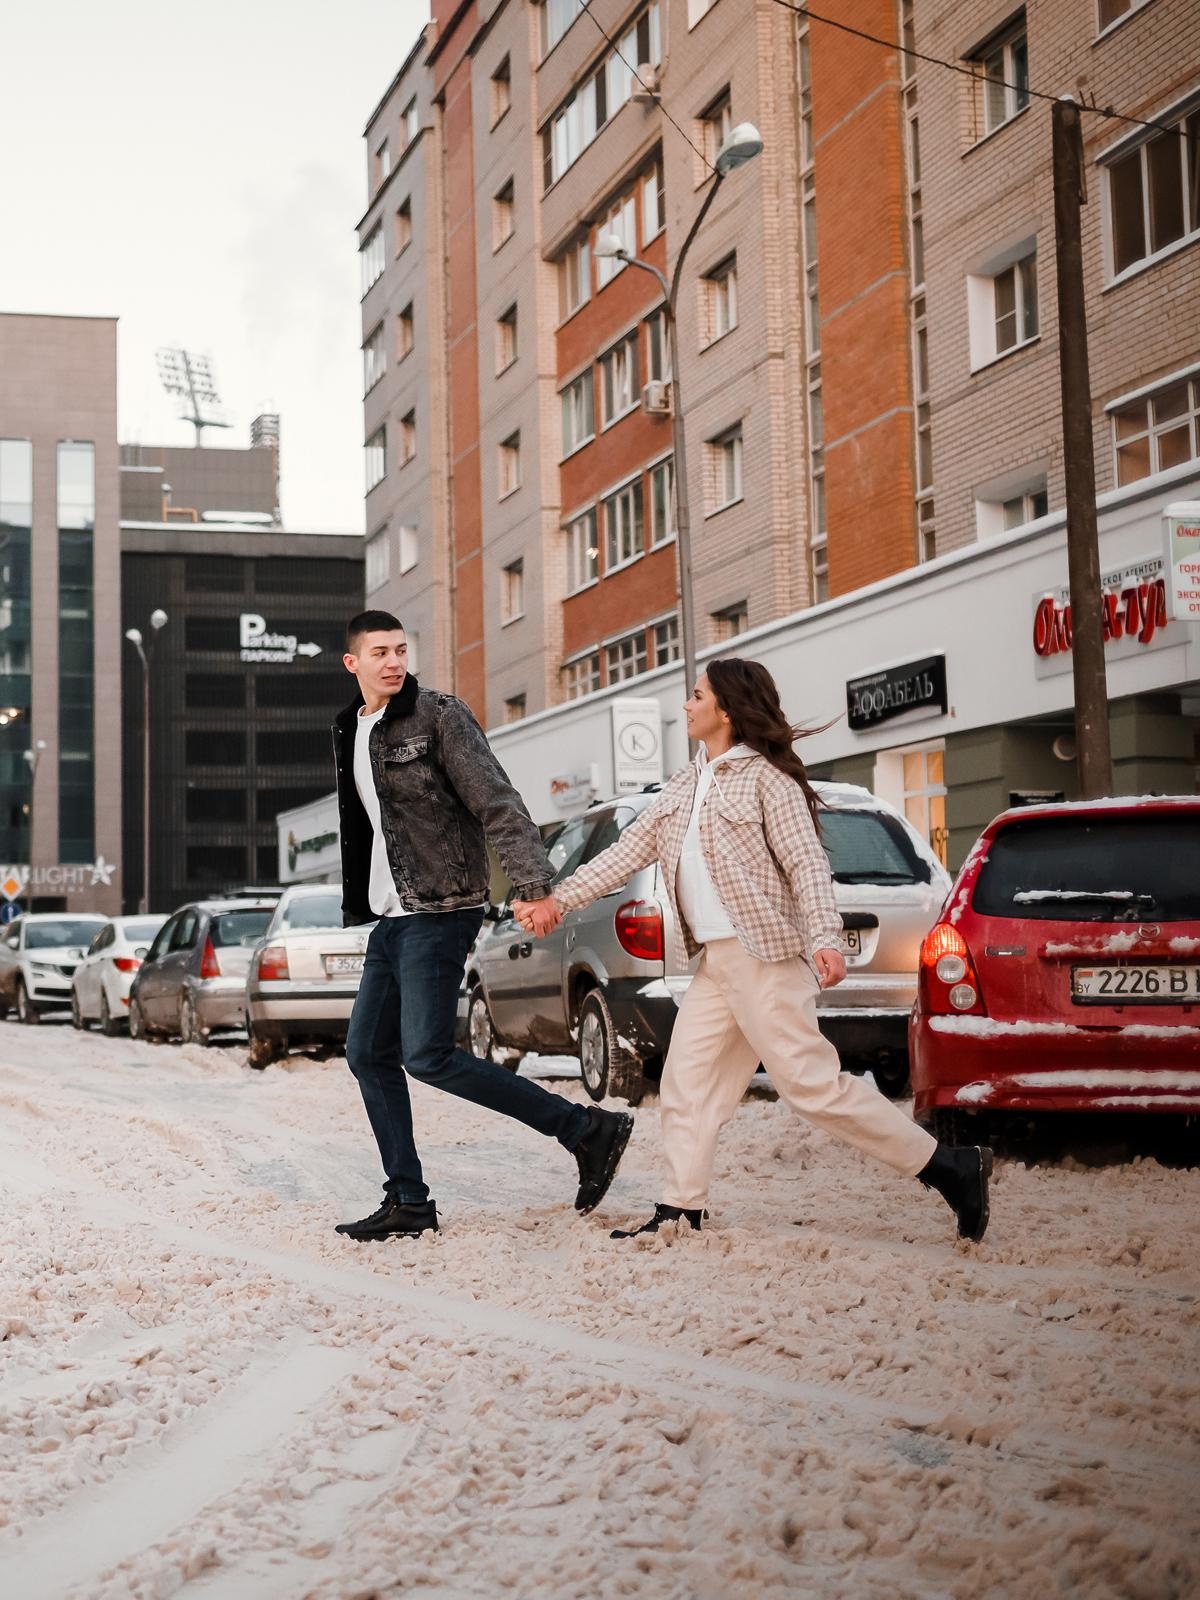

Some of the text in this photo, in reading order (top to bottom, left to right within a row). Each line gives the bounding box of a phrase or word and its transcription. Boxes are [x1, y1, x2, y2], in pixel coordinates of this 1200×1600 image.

[240, 613, 297, 652] Parking
[852, 672, 933, 720] АФФАБЕЛЬ
[1099, 969, 1160, 994] 2226
